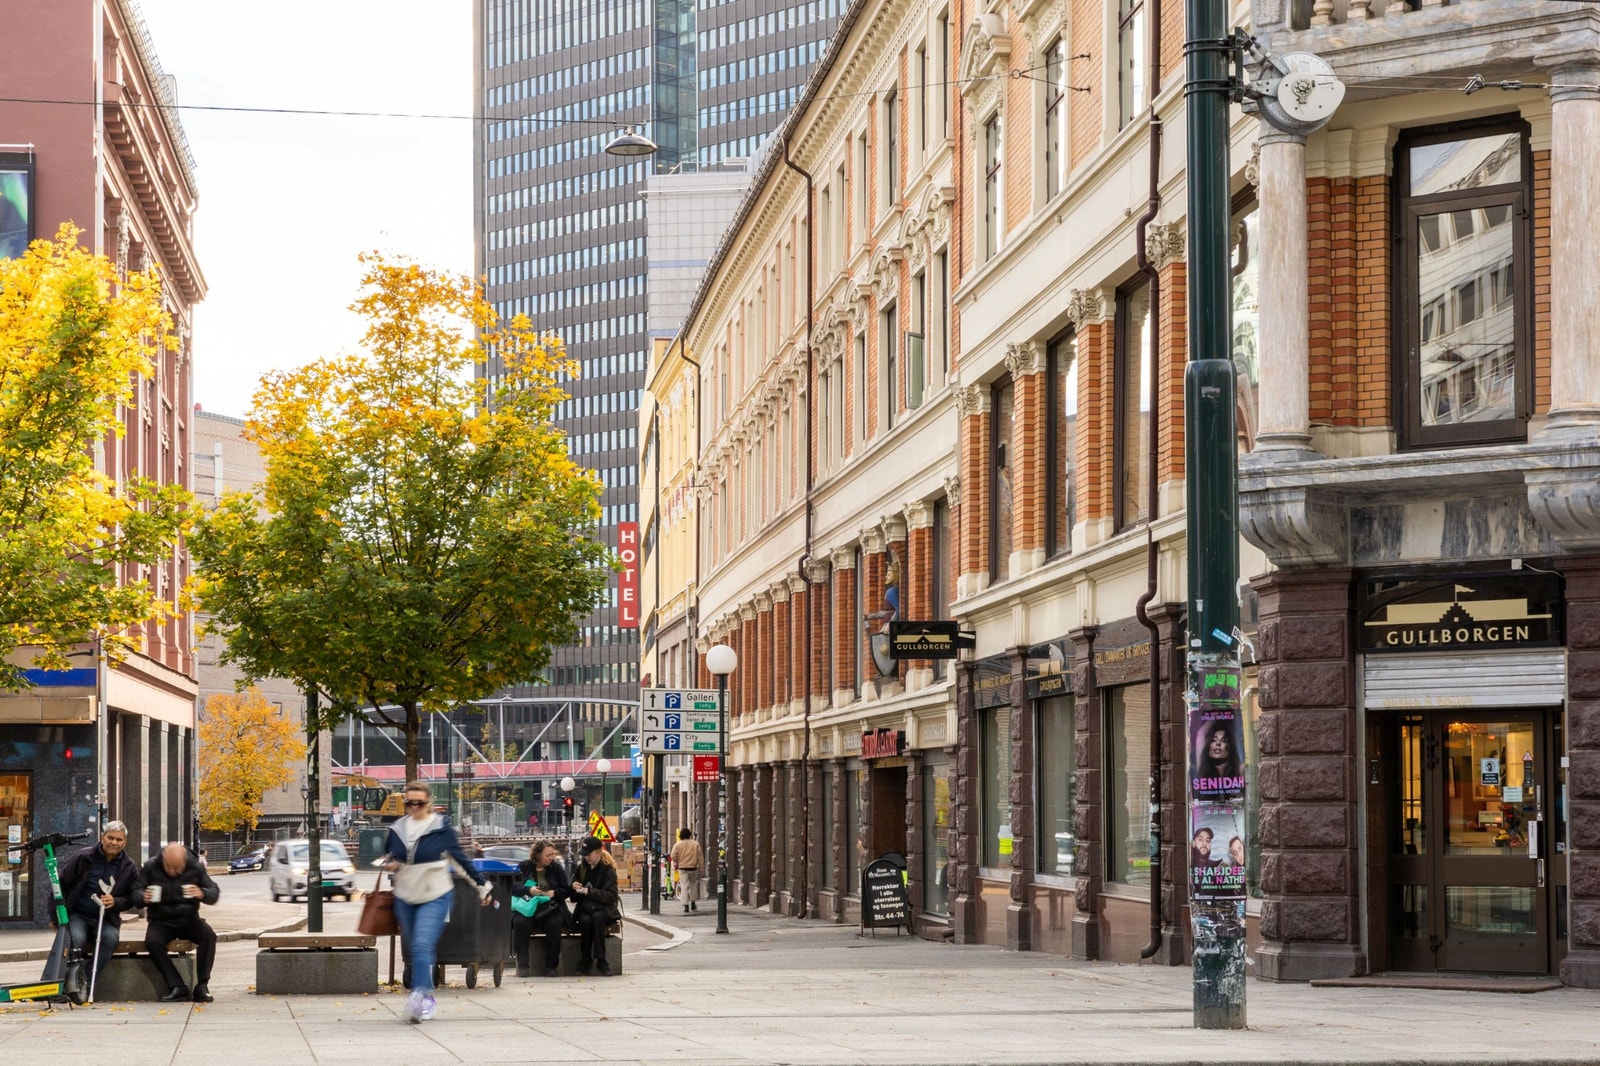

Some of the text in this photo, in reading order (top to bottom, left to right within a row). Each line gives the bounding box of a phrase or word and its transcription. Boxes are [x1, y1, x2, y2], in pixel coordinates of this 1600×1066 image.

[621, 530, 635, 621] HOTEL
[1386, 625, 1530, 645] GULLBORGEN
[669, 697, 677, 708] P
[687, 693, 714, 701] Galleri
[669, 718, 677, 729] P
[668, 738, 677, 749] P
[1193, 776, 1245, 790] SENIDAH
[1194, 866, 1246, 876] SHABJDEED
[1194, 876, 1199, 884] &
